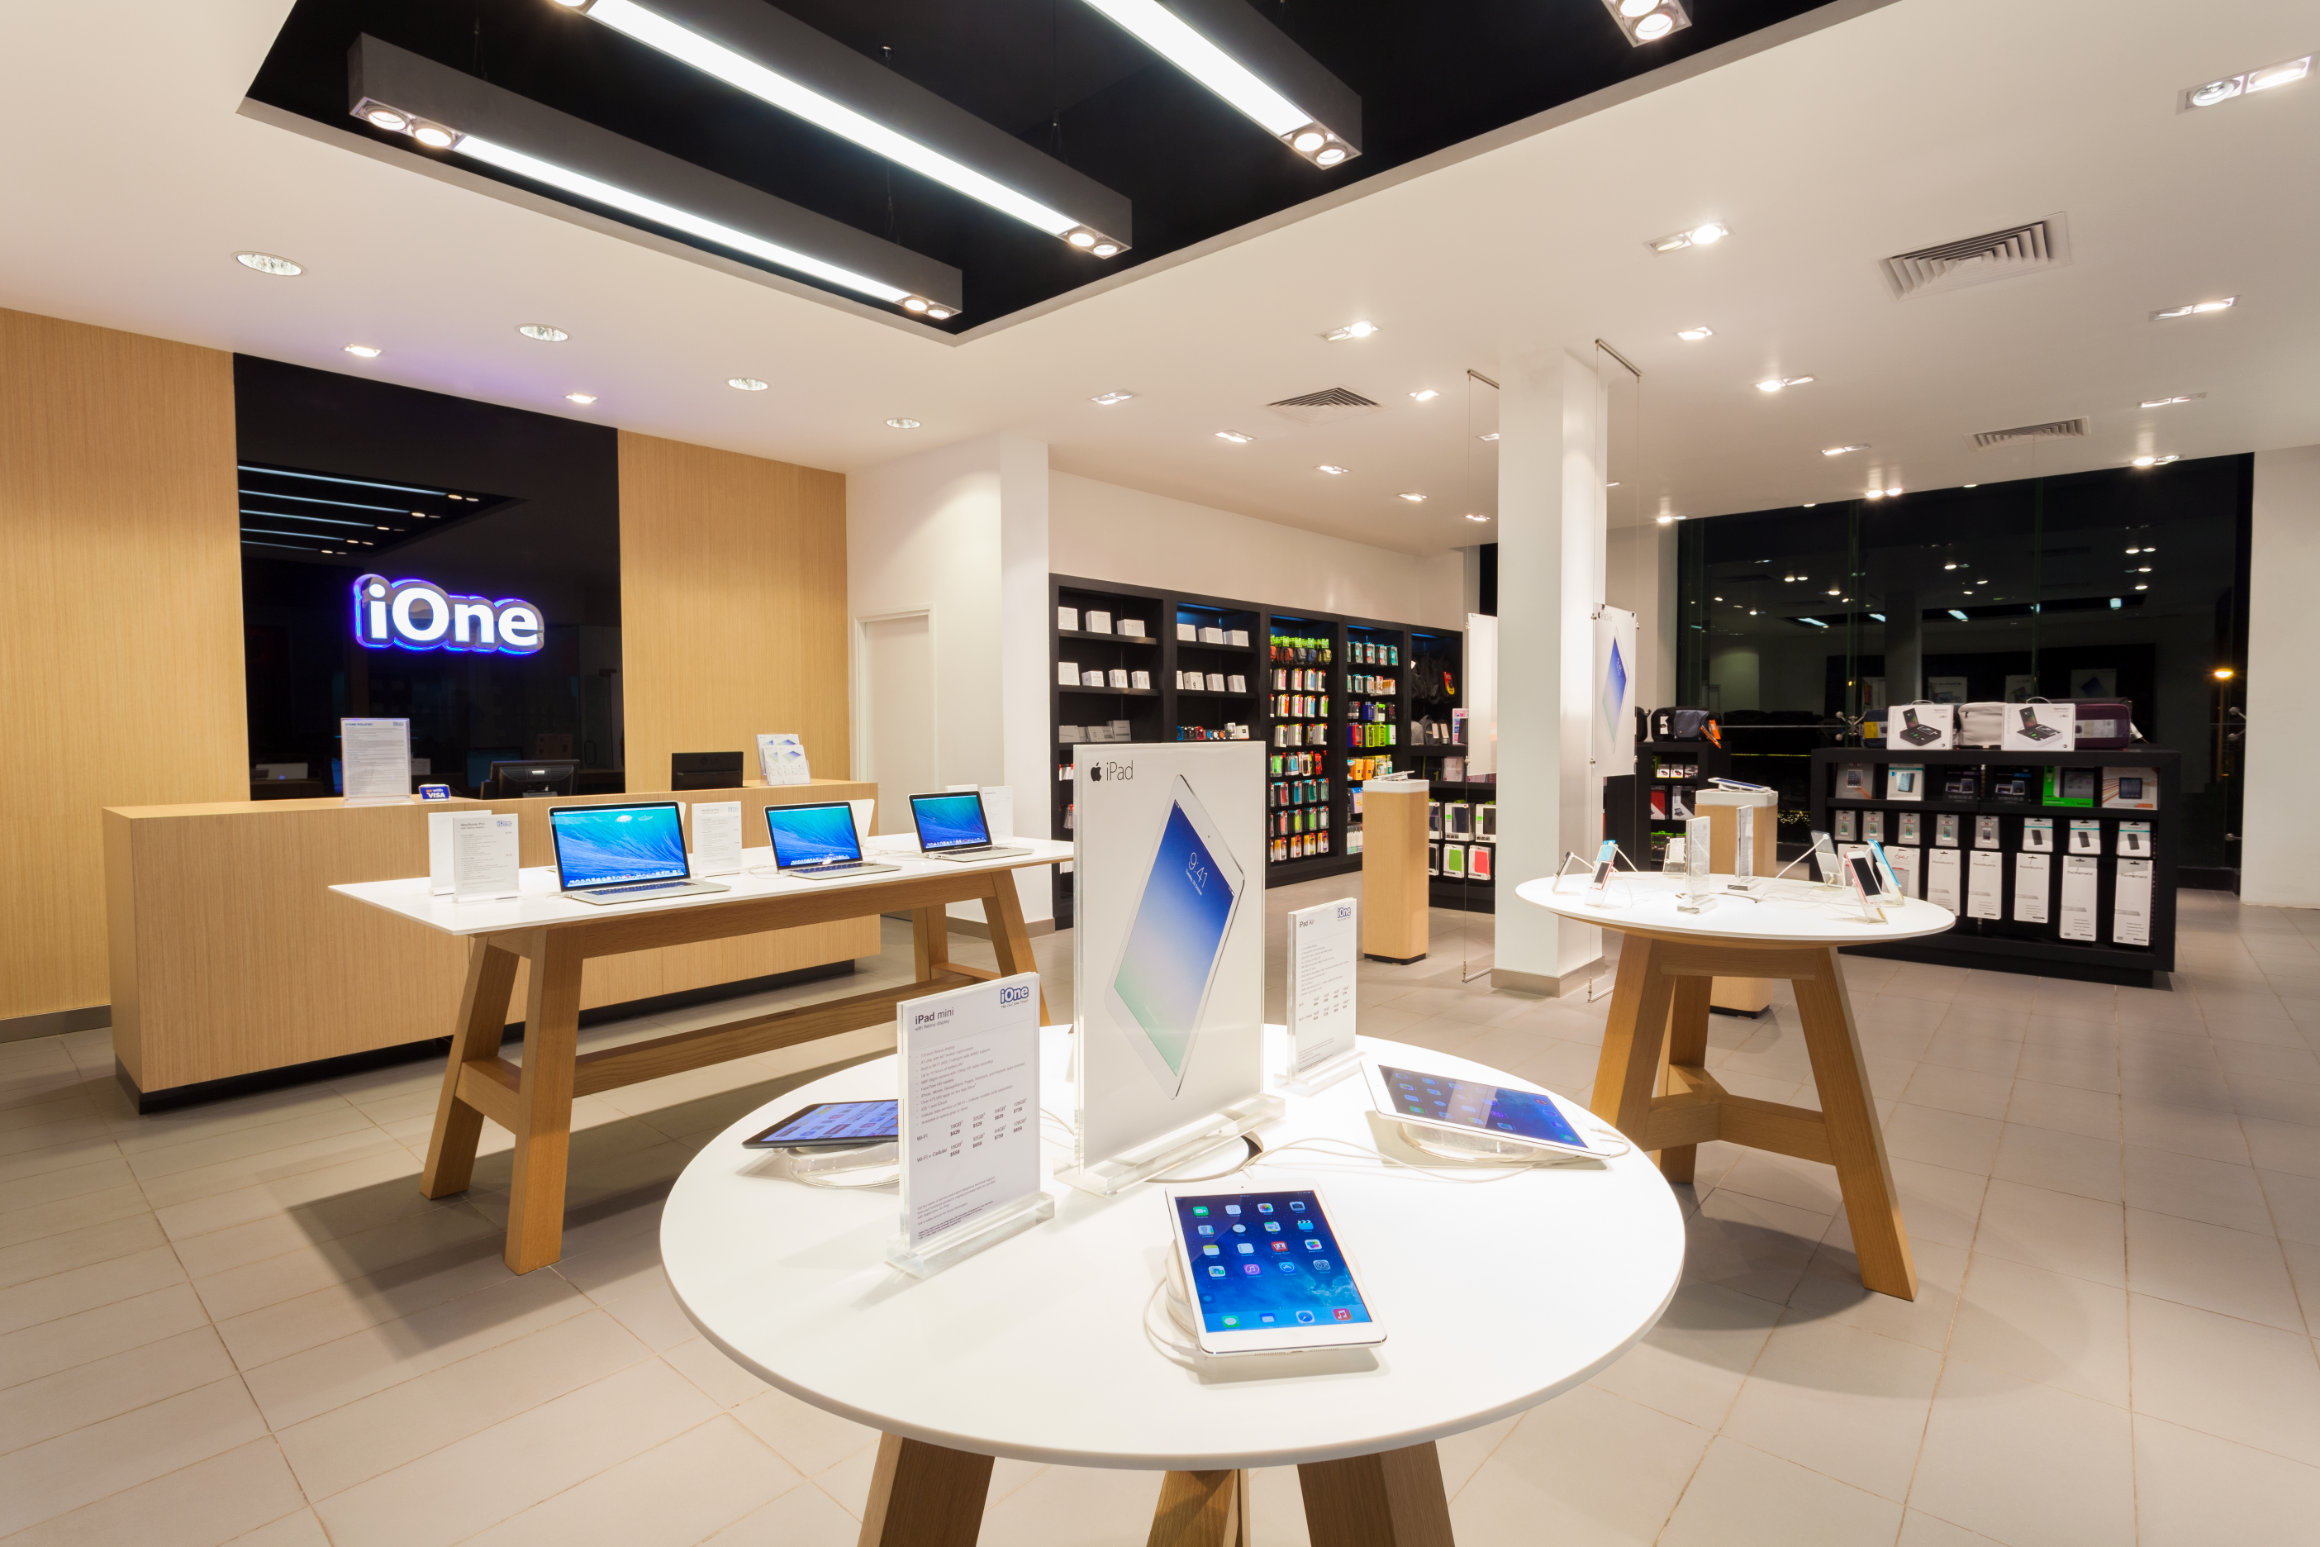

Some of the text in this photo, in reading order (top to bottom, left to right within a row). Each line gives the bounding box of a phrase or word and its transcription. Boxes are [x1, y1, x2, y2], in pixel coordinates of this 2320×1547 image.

[367, 582, 540, 647] iOne
[1106, 760, 1134, 781] iPad
[1188, 851, 1208, 888] 9:41
[1000, 986, 1029, 1004] iOne
[914, 1007, 955, 1025] iPad mini
